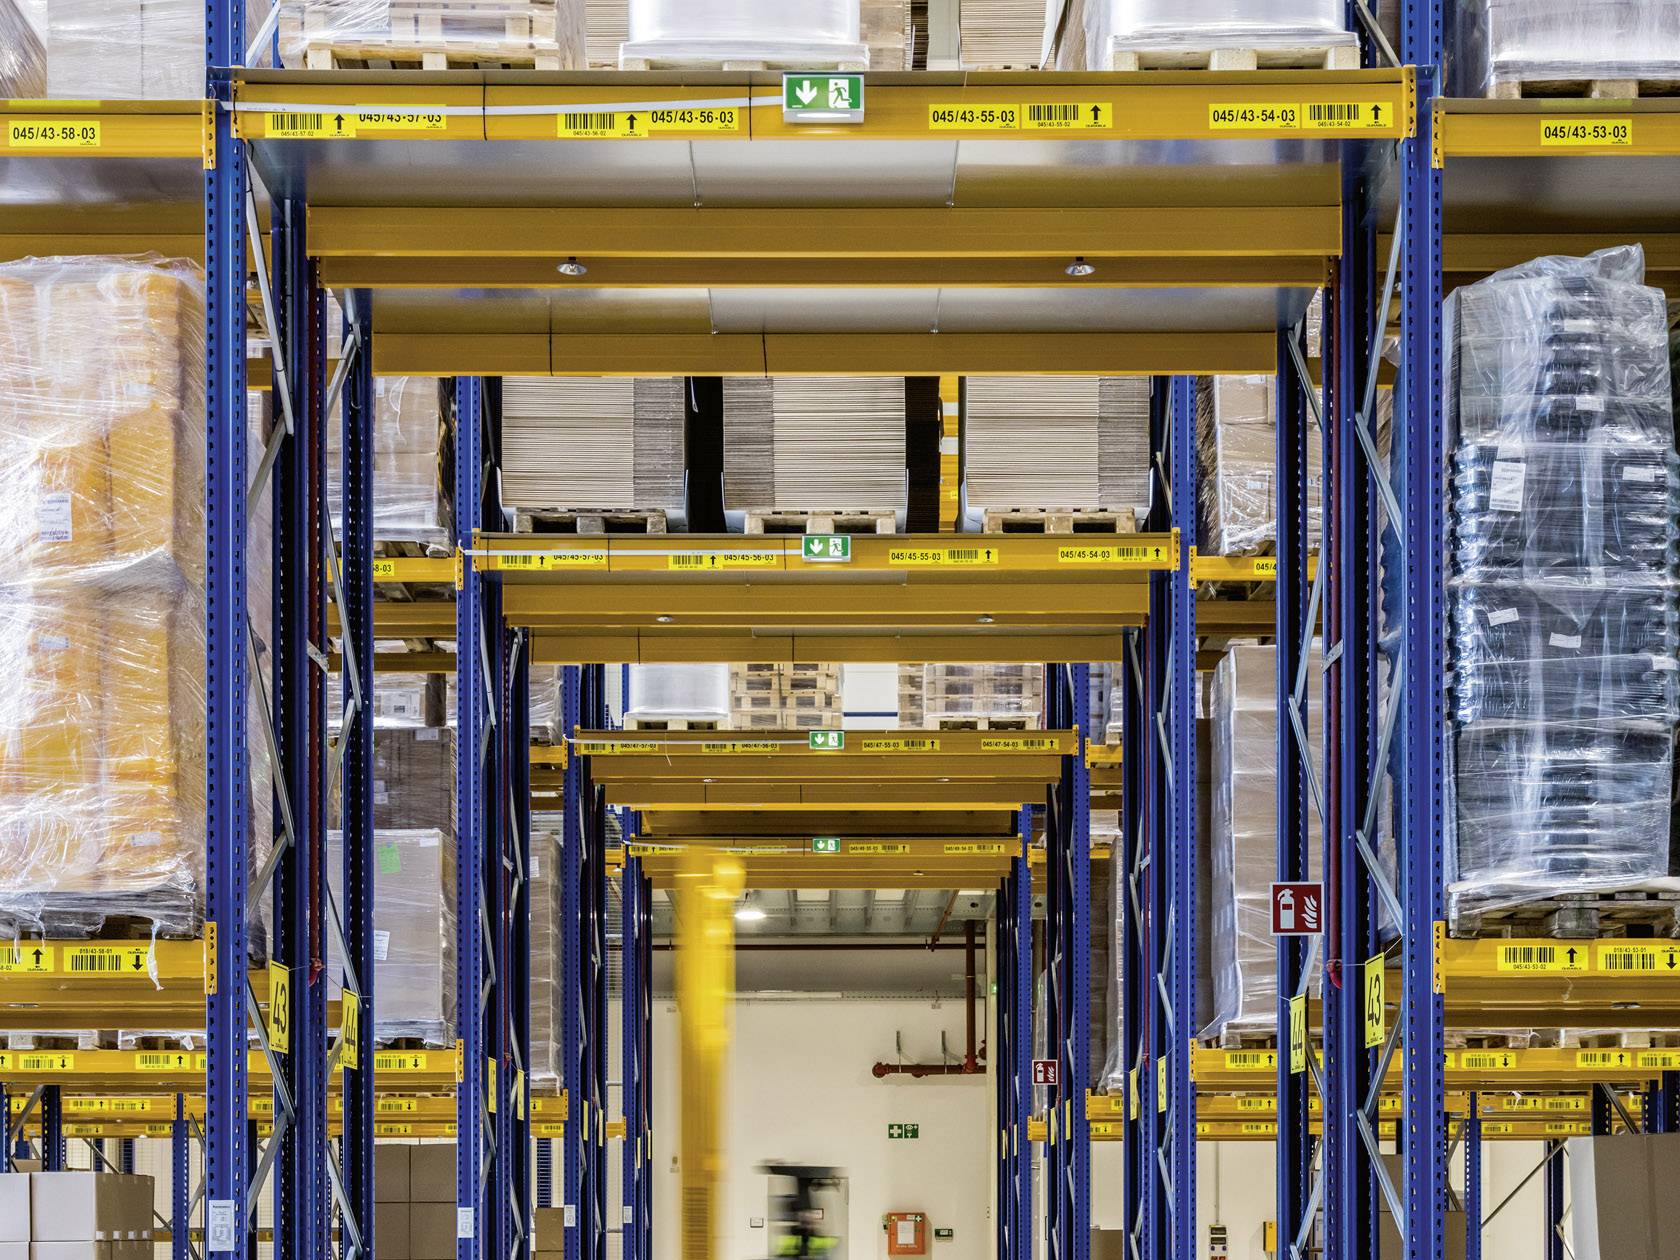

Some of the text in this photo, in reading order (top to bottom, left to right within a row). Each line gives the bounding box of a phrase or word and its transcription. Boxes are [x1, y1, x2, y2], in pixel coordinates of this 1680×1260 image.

[651, 110, 734, 124] 045/43-56-03
[932, 110, 1015, 123] 045/43-55-03
[1212, 109, 1296, 122] 045/43-54-03
[13, 127, 96, 140] 045/43-58-03
[1544, 125, 1627, 139] 045/43-53-03
[891, 552, 941, 560] 045/45-55-03
[1367, 973, 1381, 1027] 43
[272, 981, 287, 1035] 43
